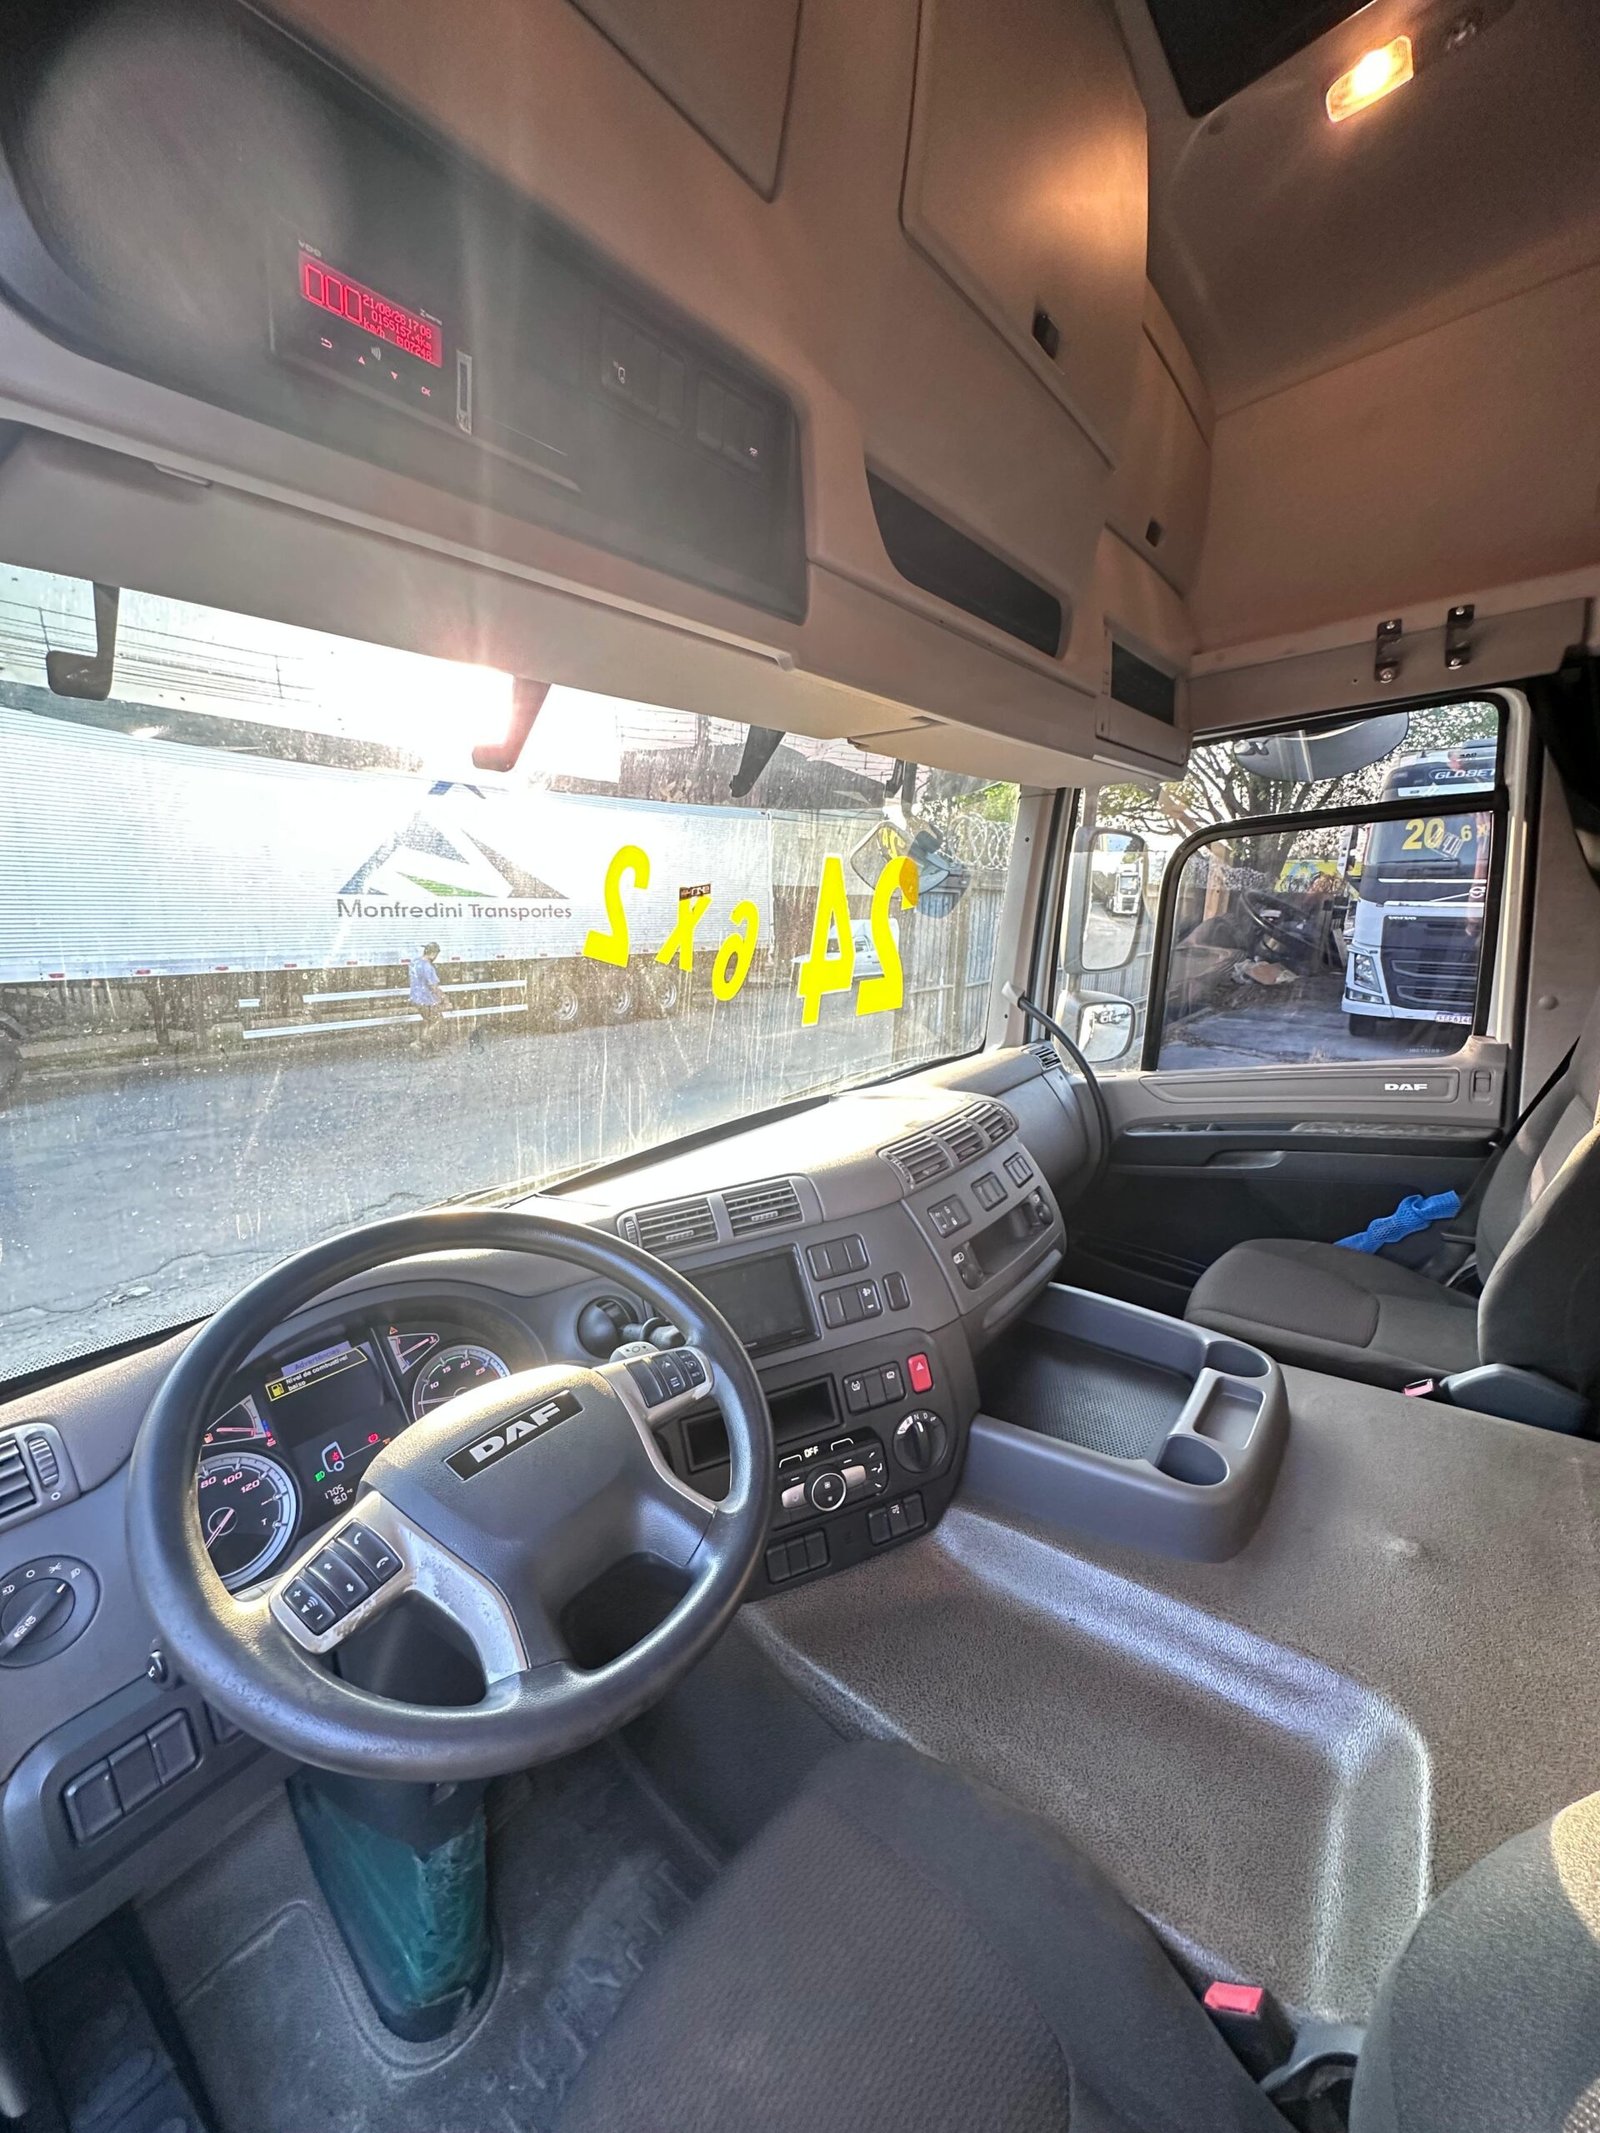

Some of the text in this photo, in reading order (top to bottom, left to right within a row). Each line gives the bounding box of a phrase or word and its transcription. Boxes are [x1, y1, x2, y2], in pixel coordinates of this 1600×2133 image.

[298, 239, 322, 257] VDO
[420, 386, 432, 397] OK
[1402, 818, 1445, 850] 20
[336, 898, 572, 921] Monfredini Transportes
[1384, 1083, 1428, 1091] DAF
[442, 1365, 452, 1374] 15
[459, 1360, 471, 1369] 20
[475, 1366, 486, 1376] 25
[302, 1370, 312, 1378] de
[430, 1381, 440, 1390] 10
[468, 1401, 561, 1463] DAF
[803, 1445, 819, 1458] OFF
[200, 1476, 217, 1489] 80
[222, 1471, 243, 1486] 100
[240, 1479, 260, 1494] 120
[324, 1483, 345, 1500] 17:05
